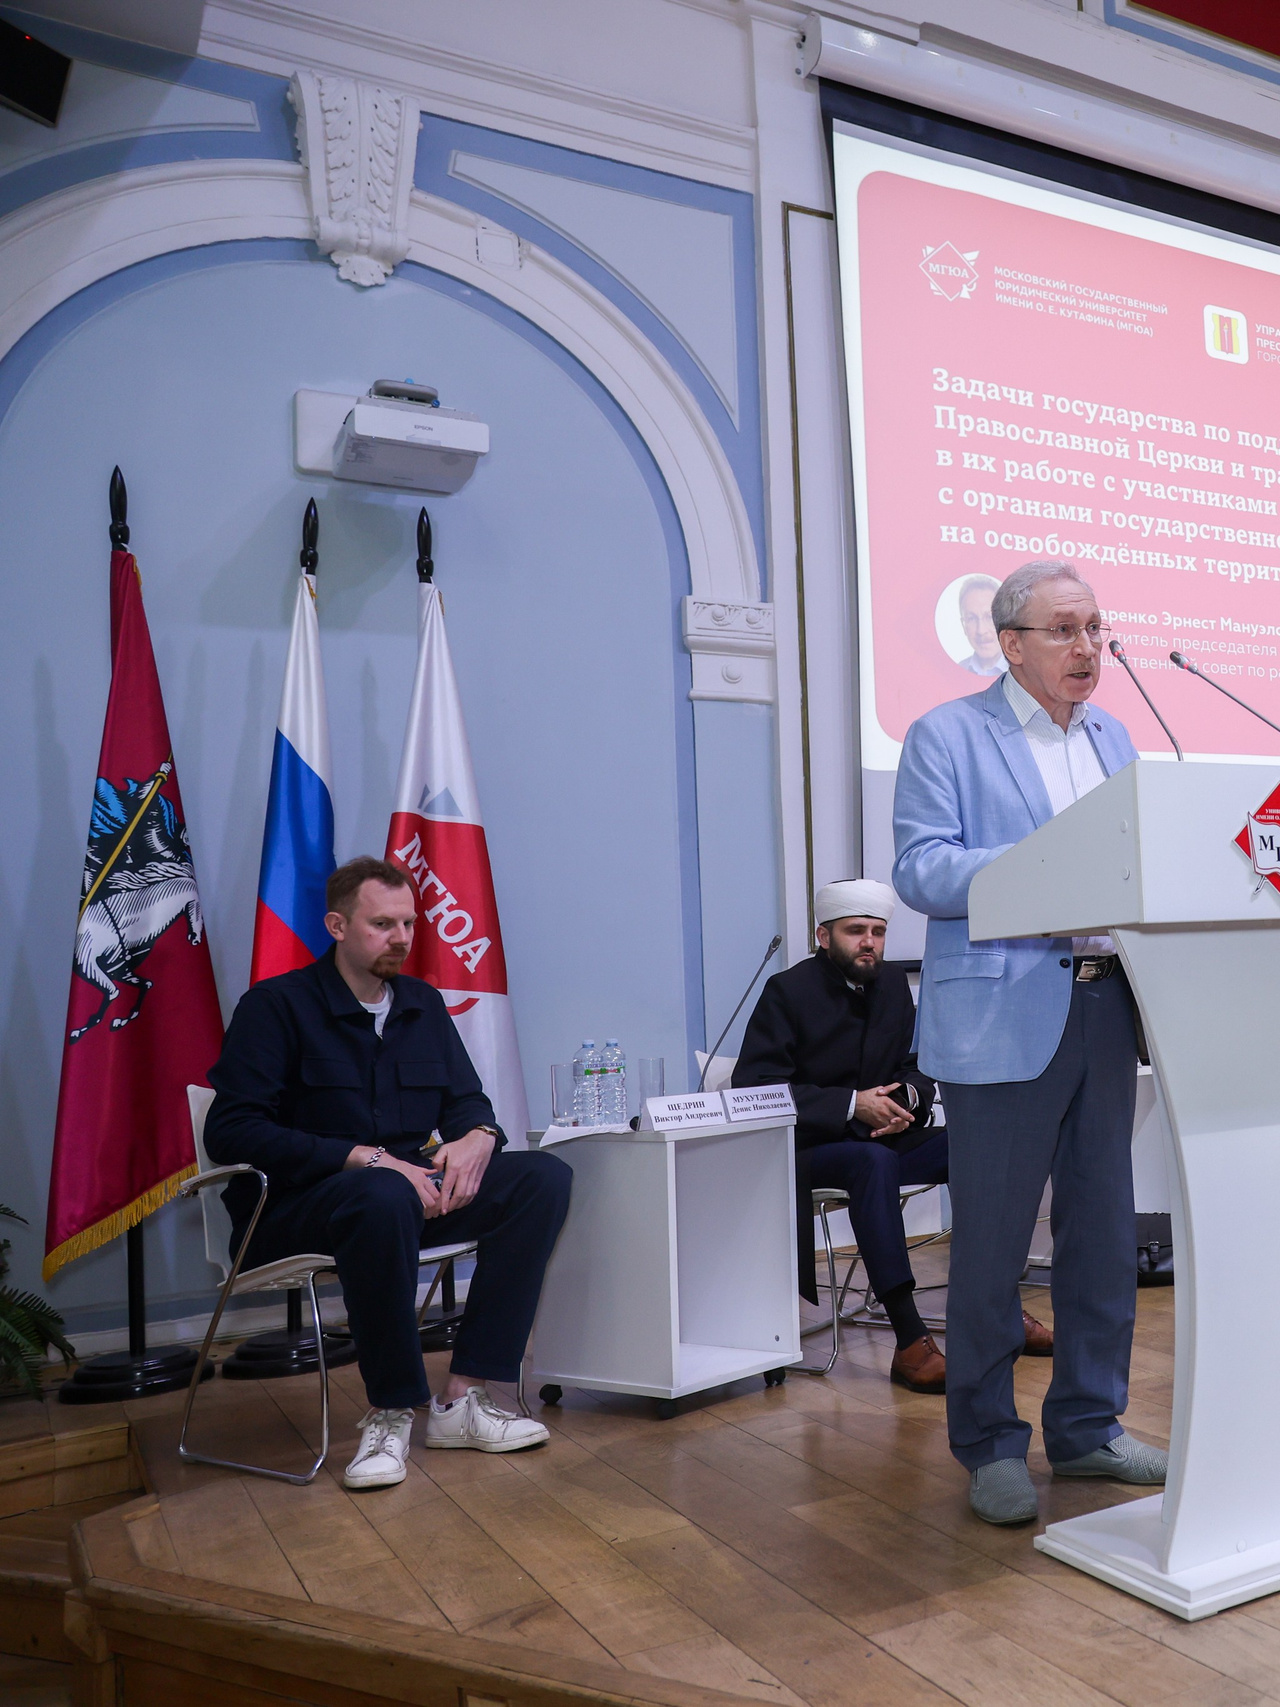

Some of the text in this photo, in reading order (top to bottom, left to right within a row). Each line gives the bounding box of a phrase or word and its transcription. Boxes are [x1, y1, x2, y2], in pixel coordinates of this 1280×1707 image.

[929, 262, 969, 279] МГЮА
[994, 266, 1168, 315] МОСКОВСКИЙ ГОСУДАРСТВЕННЫЙ
[994, 279, 1147, 322] ЮРИДИЧЕСКИЙ УНИВЕРСИТЕТ
[995, 293, 1154, 337] ИМЕНИ О. Е. КУТАФИНА (МГЮА)
[932, 368, 1034, 407] Задачи
[1042, 393, 1197, 437] государства
[1203, 424, 1231, 442] по
[934, 405, 1130, 459] Православной
[1137, 440, 1224, 475] Церкви
[1231, 460, 1245, 478] и
[936, 450, 953, 466] в
[962, 452, 996, 473] их
[1004, 459, 1096, 489] работе
[1103, 474, 1116, 491] с
[1122, 478, 1277, 516] участниками
[938, 487, 953, 504] с
[963, 488, 1093, 524] органами
[940, 525, 976, 545] на
[984, 529, 1197, 572] освобождённых
[1099, 609, 1158, 625] аренко
[1162, 611, 1216, 630] Эрнест
[1109, 632, 1168, 648] титель
[1173, 637, 1277, 657] председателя
[1202, 661, 1244, 676] совет
[1247, 664, 1266, 677] по
[393, 832, 491, 974] МГЮА
[667, 1100, 706, 1112] ЩЕДРИН
[731, 1101, 792, 1114] Денис Николаевич
[732, 1091, 785, 1104] МУХУТДИНОВ
[654, 1110, 723, 1125] Виктор Андреевич
